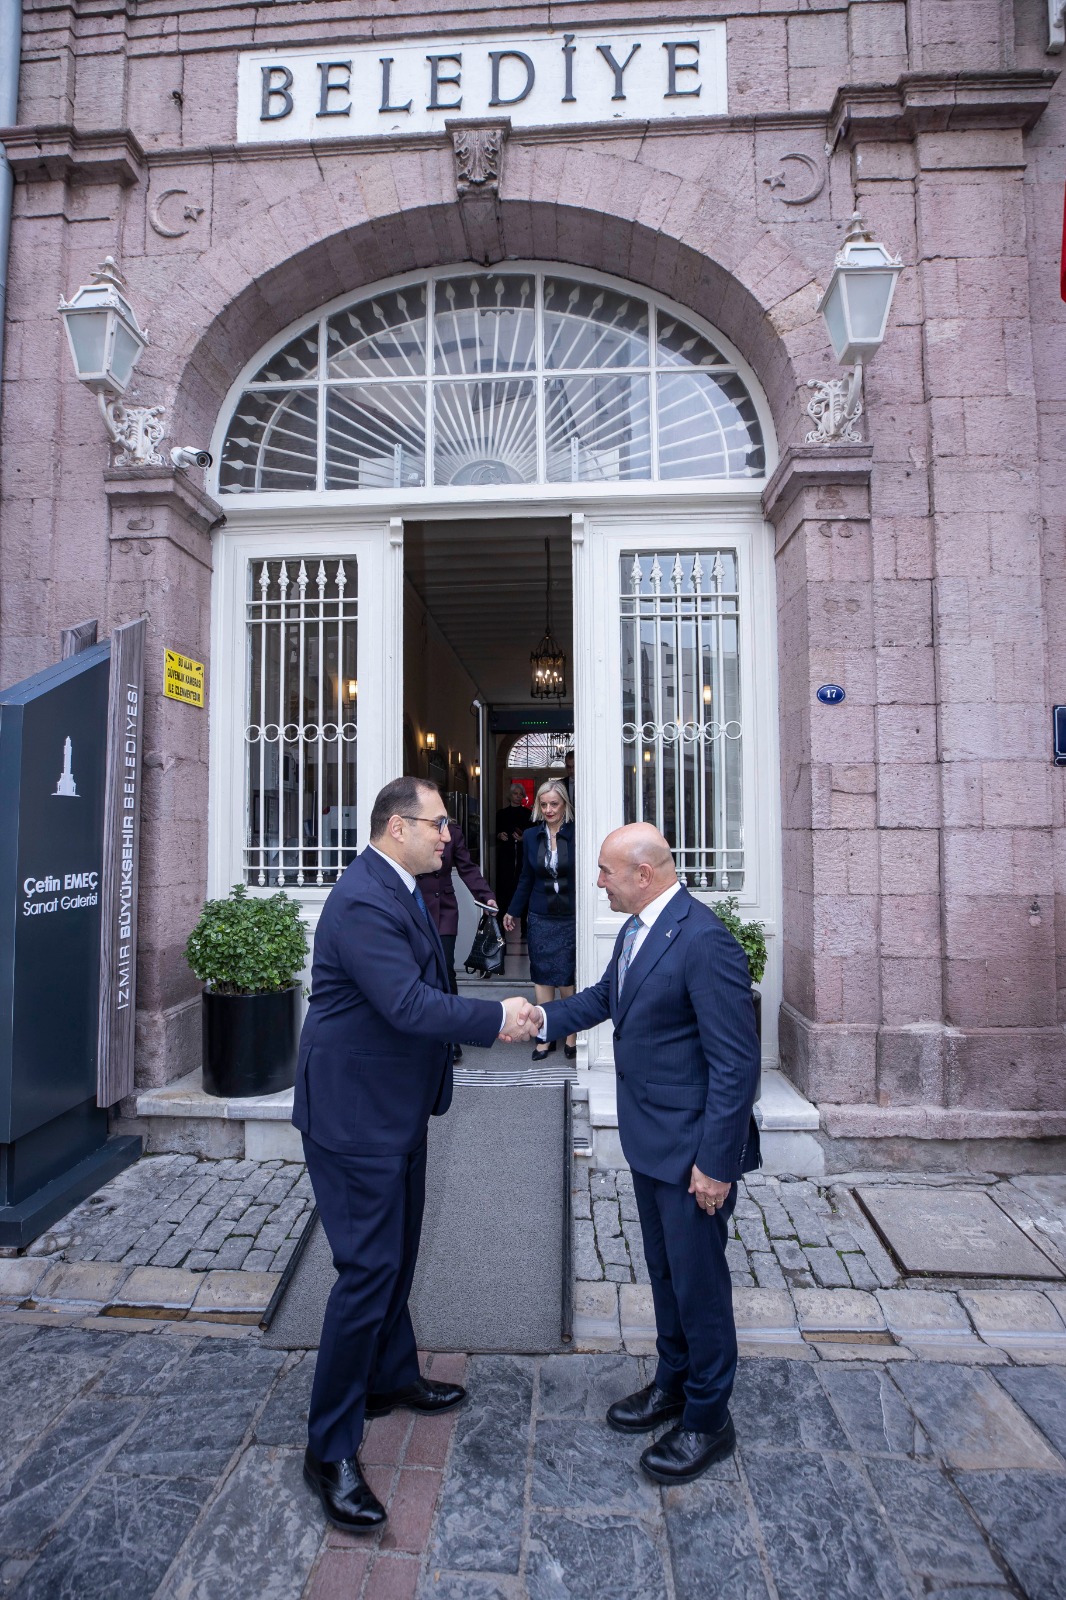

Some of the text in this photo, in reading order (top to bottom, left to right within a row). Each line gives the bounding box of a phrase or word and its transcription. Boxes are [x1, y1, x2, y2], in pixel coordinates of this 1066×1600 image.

[260, 34, 702, 121] BELEDİYE
[826, 689, 837, 699] 17
[23, 871, 99, 898] Çetin EMEÇ
[118, 815, 134, 940] BÜYÜKŞEHİR
[22, 892, 98, 917] Sanat Galerisi
